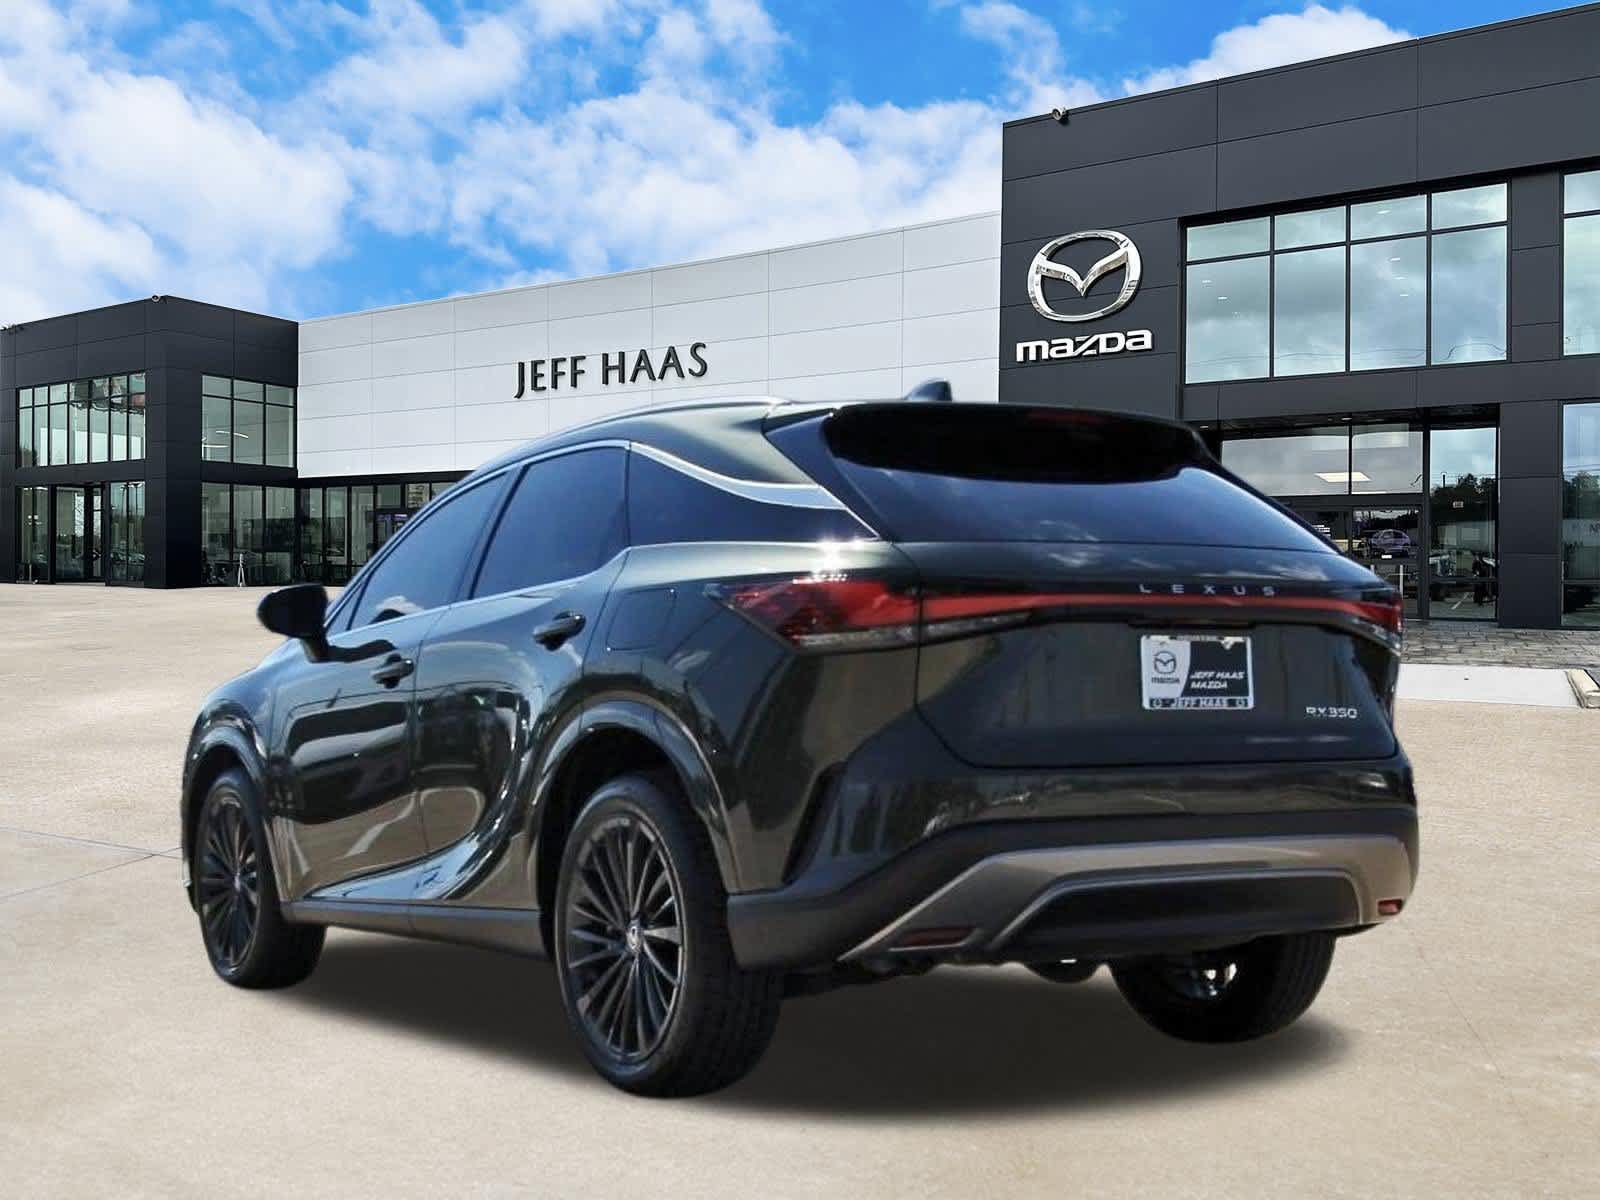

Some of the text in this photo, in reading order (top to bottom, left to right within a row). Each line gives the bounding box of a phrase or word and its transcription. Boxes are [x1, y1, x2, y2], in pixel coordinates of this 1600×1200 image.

[514, 342, 708, 399] JEFF HAAS
[1139, 583, 1275, 597] LEXUS
[1190, 671, 1245, 680] JEFF HAAS
[1190, 681, 1228, 689] MAZDA
[1170, 698, 1229, 708] JEFF HAAS
